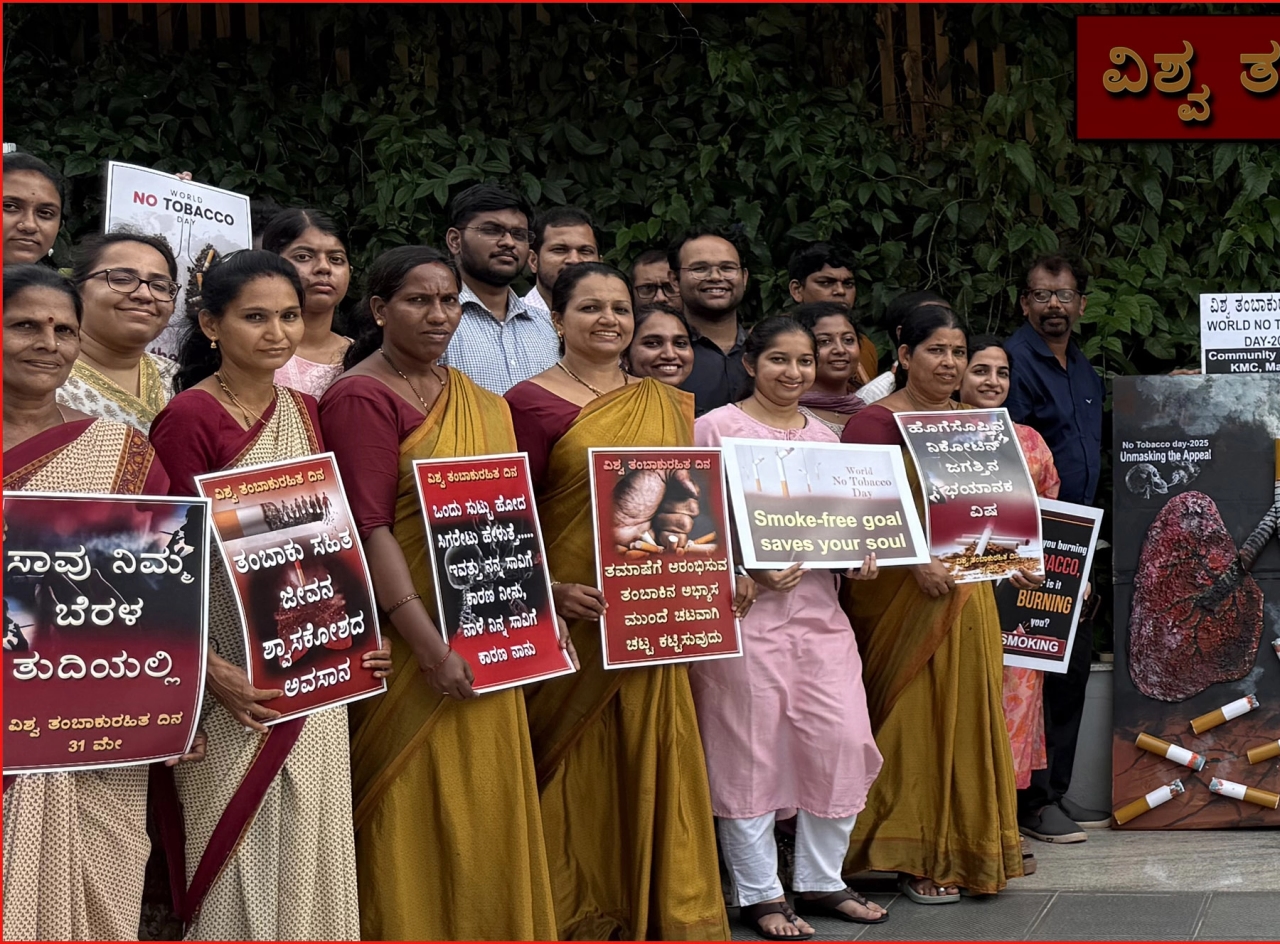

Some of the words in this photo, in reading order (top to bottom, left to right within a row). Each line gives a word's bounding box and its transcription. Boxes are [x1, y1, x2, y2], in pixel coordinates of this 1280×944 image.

[170, 189, 203, 204] WORLD
[133, 191, 158, 207] NO
[163, 197, 235, 226] TOBACCO
[177, 216, 196, 226] DAY
[1210, 294, 1231, 319] ವಿಶ್ವ
[1207, 320, 1251, 331] WORLD
[1254, 319, 1271, 330] NO
[1208, 351, 1276, 361] Community
[1230, 362, 1262, 373] KMC,
[1122, 441, 1134, 449] No
[1172, 439, 1209, 449] day-2025
[1120, 450, 1166, 463] Unmasking
[1167, 450, 1181, 461] the
[1183, 449, 1212, 462] Appeal
[846, 466, 873, 476] World
[946, 459, 999, 476] ಜಗತ್ತಿನ
[832, 476, 847, 486] No
[849, 476, 892, 487] Tobacco
[943, 479, 1013, 499] ಭಯಾನಕ
[852, 488, 873, 499] Day
[433, 500, 462, 518] ಒಂದು
[494, 494, 526, 512] ಹೋದ
[970, 503, 998, 518] ವಿಷ
[754, 509, 857, 527] Smoke-free
[863, 511, 902, 531] goal
[233, 538, 304, 573] ತಂಬಾಕು
[310, 526, 353, 556] ಸಹಿತ
[760, 537, 814, 552] saves
[818, 538, 860, 555] your
[866, 533, 906, 550] soul
[1042, 539, 1056, 549] you
[1057, 540, 1087, 556] burning
[7, 544, 91, 581] ಸಾವು
[112, 546, 195, 584] ನಿಮ್ಮ
[485, 555, 505, 579] ನನ್ನ
[505, 550, 533, 569] ಸಾವಿಗೆ
[279, 574, 334, 609] ಜೀವನ
[620, 584, 676, 601] ತಂಬಾಕಿನ
[681, 582, 719, 603] ಅಭ್ಯಾಸ
[1046, 579, 1054, 588] is
[1055, 580, 1062, 590] it
[55, 596, 144, 626] ಬೆರಳ
[1016, 589, 1073, 614] BURNING
[463, 616, 484, 637] ನಾಳೆ
[488, 614, 510, 638] ನಿನ್ನ
[509, 608, 538, 629] ಸಾವಿಗೆ
[624, 608, 668, 627] ಮುಂದೆ
[674, 606, 720, 622] ಚಟವಾಗಿ
[1030, 618, 1050, 628] you?
[262, 610, 365, 669] ಶ್ವಾಸಕೋಶದ
[1001, 634, 1059, 652] SMOKING
[478, 645, 508, 664] ಕಾರಣ
[510, 639, 536, 658] ನಾನು
[12, 650, 181, 686] ತುದಿಯಲ್ಲಿ
[284, 658, 351, 697] ಅವಸಾನ
[8, 717, 41, 738] ವಿಶ್ವ
[48, 712, 150, 731] ತಂಬಾಕುರಹಿತ
[157, 711, 183, 726] ದಿನ
[68, 740, 86, 753] 31
[93, 737, 123, 751] ಮೇ
